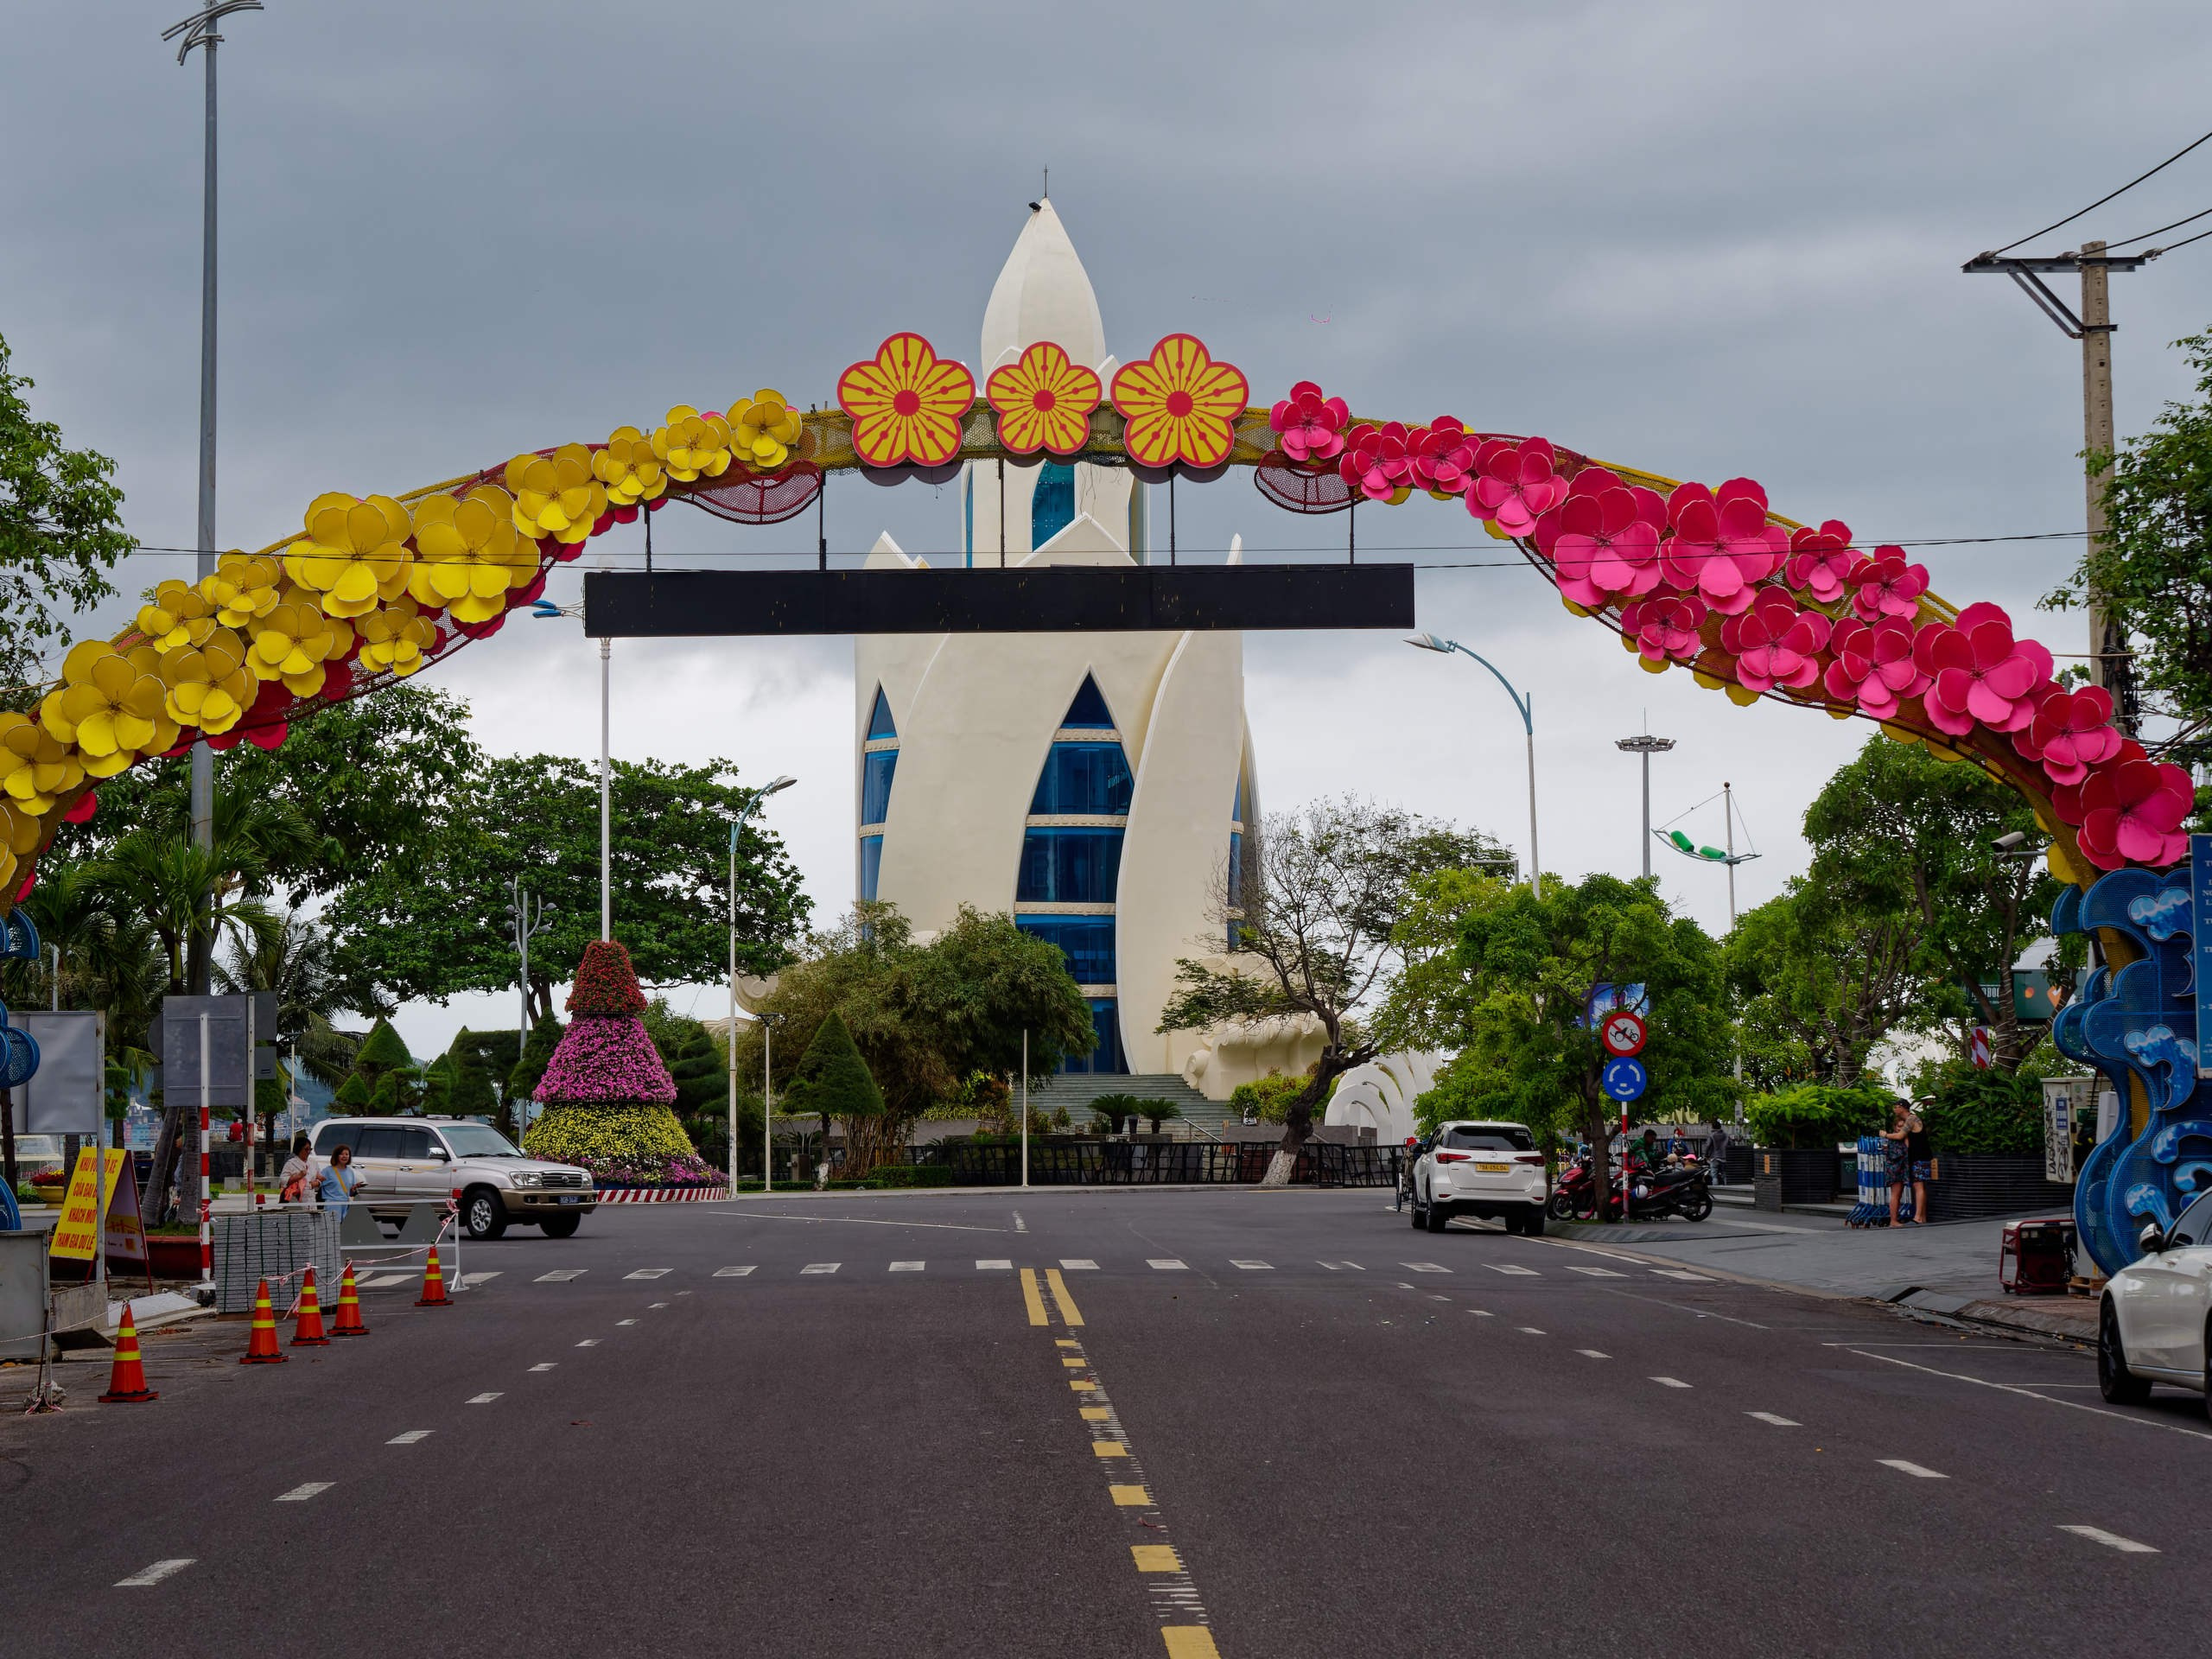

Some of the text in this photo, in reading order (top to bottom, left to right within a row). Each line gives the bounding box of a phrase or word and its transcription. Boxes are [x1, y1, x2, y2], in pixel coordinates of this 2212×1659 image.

[79, 1156, 92, 1172] KHU
[109, 1159, 118, 1174] XE
[73, 1177, 85, 1197] CỦA
[67, 1204, 86, 1223] KHÁCH
[54, 1232, 71, 1248] THAM
[68, 1233, 79, 1249] GIA
